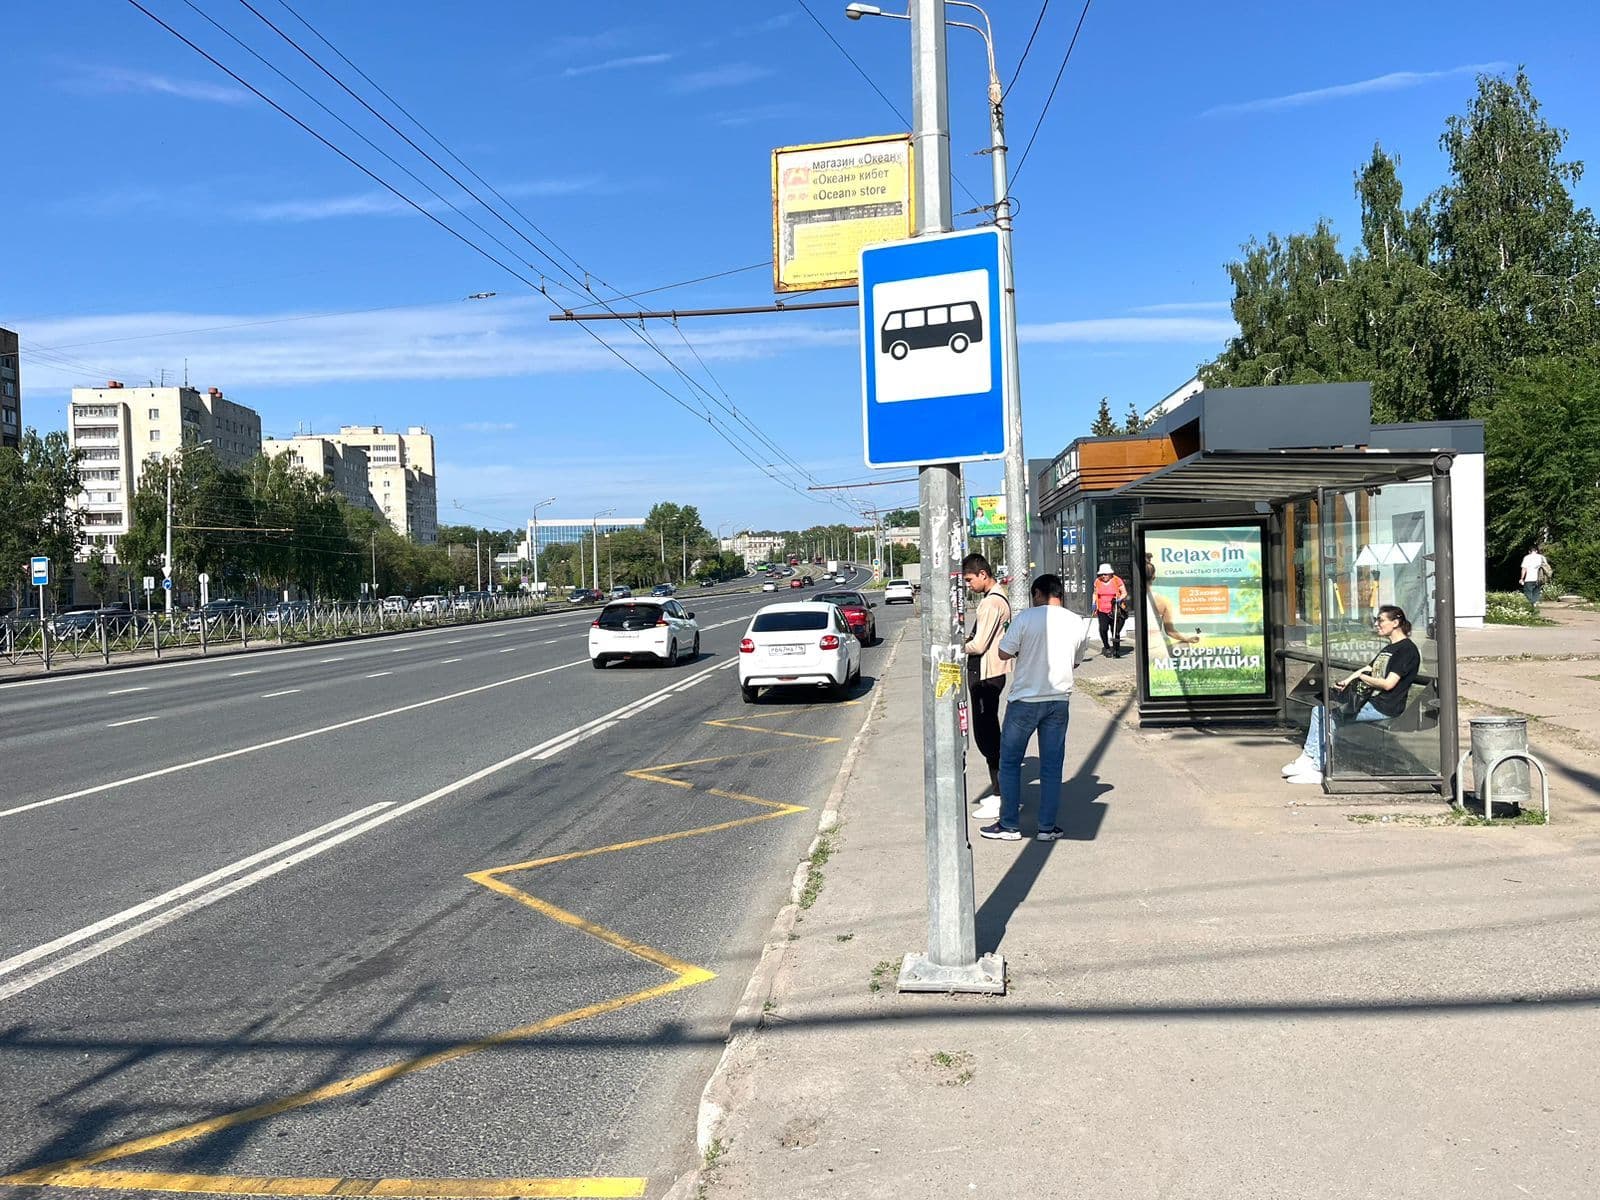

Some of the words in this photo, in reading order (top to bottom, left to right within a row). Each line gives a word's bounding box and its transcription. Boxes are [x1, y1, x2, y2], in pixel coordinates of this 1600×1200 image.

[812, 156, 855, 170] магазин
[812, 173, 856, 185] «Океан»
[859, 168, 889, 181] кибет
[812, 188, 857, 201] «Ocean»
[859, 185, 887, 196] store
[1161, 547, 1211, 564] Relax
[1172, 645, 1241, 657] ОТКРЫТАЯ
[1154, 655, 1260, 671] МЕДИТАЦИЯ
